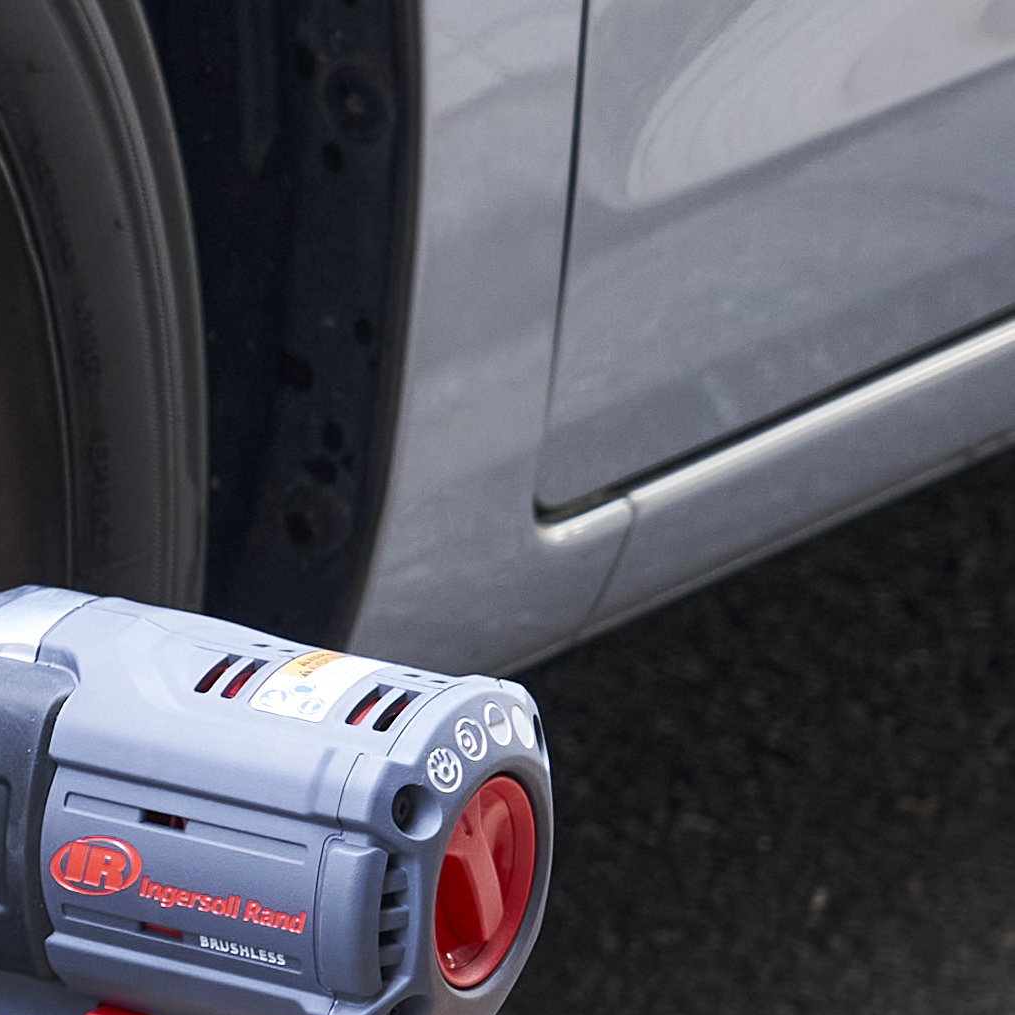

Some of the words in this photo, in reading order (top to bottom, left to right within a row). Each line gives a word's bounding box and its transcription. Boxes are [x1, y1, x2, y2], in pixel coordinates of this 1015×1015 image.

[63, 841, 127, 891] IR
[139, 875, 241, 919] Ingersoll
[242, 899, 307, 934] Rand
[199, 935, 286, 966] BRUSHLESS
